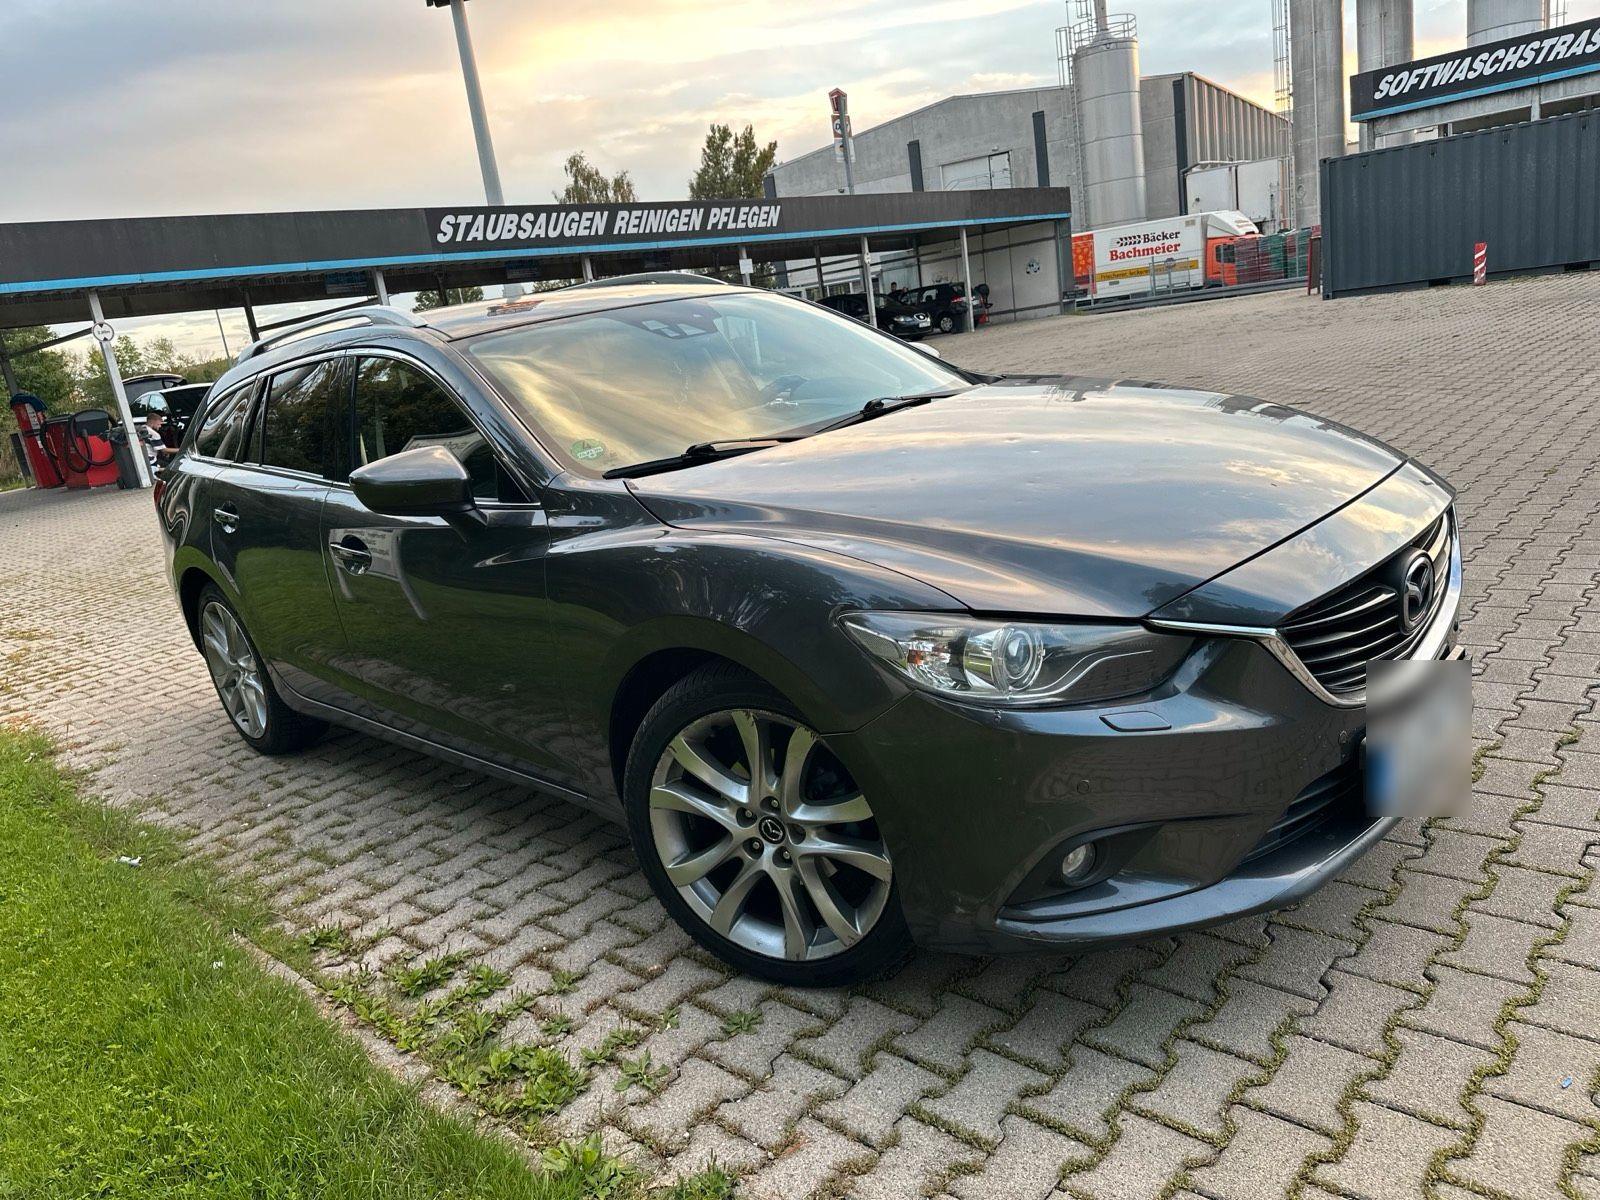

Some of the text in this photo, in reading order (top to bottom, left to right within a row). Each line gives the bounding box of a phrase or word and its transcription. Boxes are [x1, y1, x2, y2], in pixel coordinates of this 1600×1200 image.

[436, 205, 781, 243] STAUBSAUGEN REINIGEN PFLEGEN
[1143, 230, 1180, 243] Bäcker
[1109, 242, 1180, 261] Bachmeier
